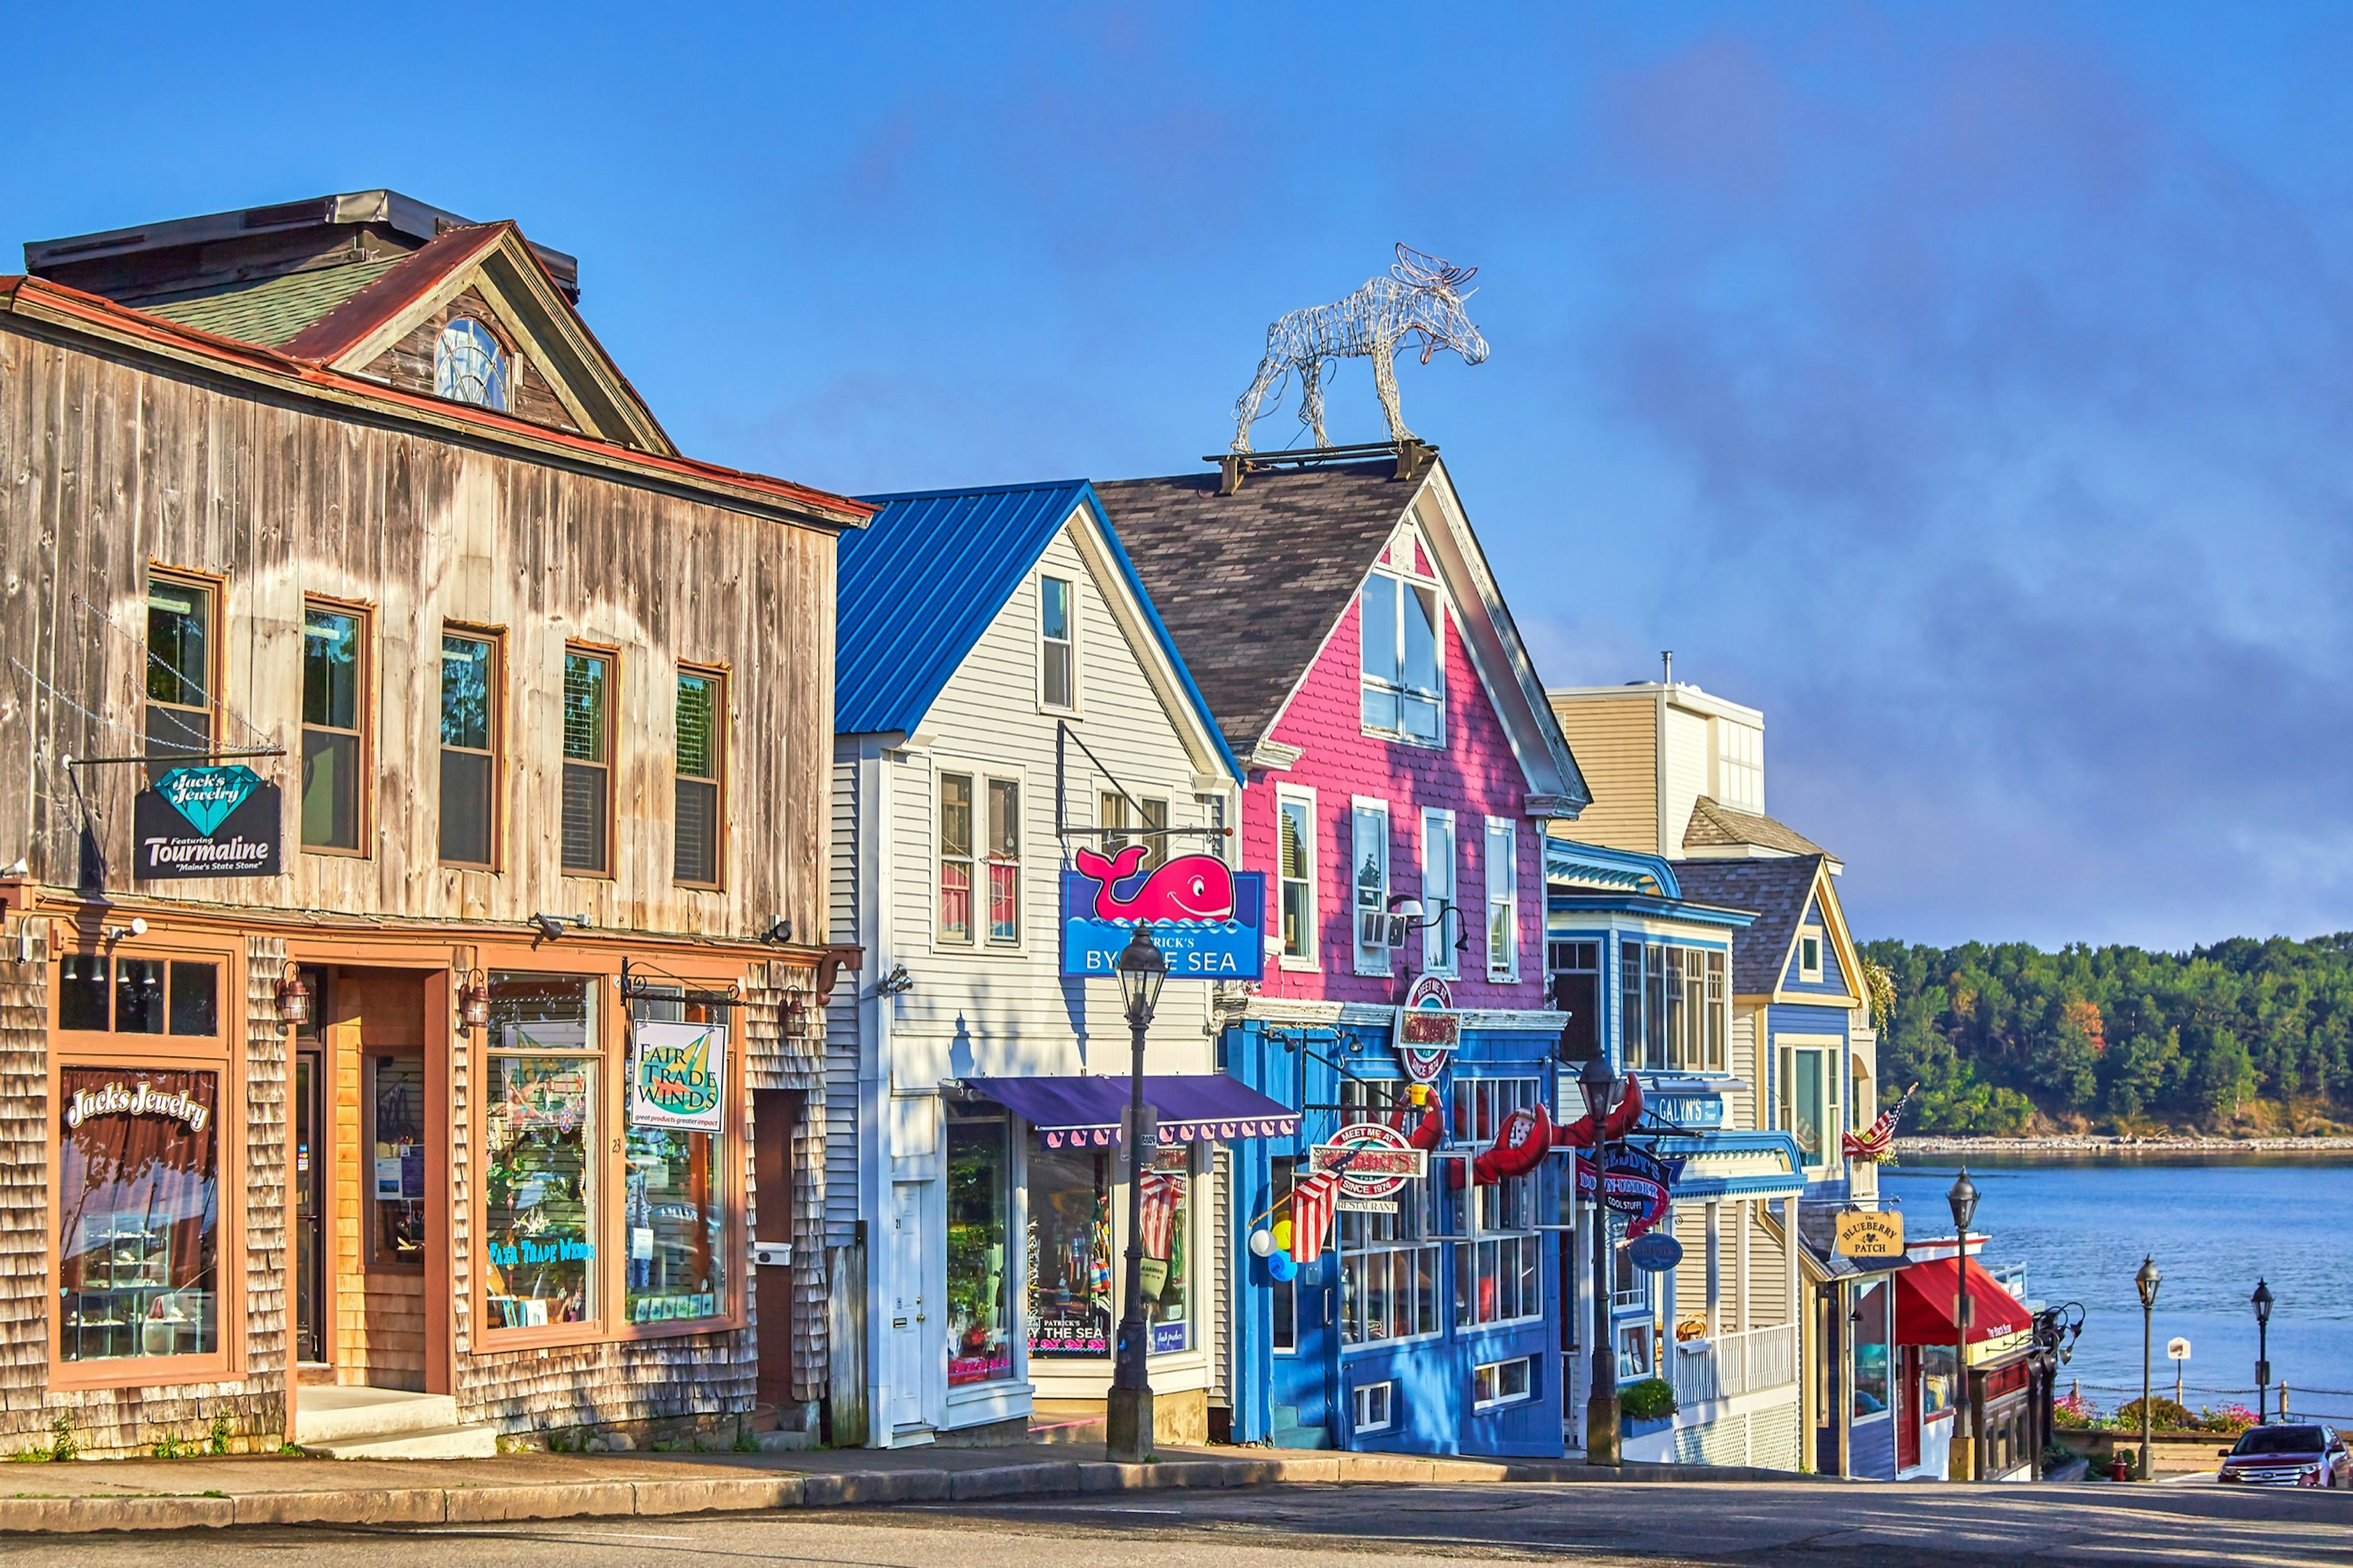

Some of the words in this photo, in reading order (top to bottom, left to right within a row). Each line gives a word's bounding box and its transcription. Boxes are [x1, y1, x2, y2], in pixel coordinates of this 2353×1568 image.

[173, 774, 225, 789] Jack's
[173, 788, 239, 804] Jewelry
[144, 835, 269, 866] Tourmaline
[175, 863, 210, 873] "Maine's
[211, 862, 234, 870] State
[1130, 937, 1194, 948] RICK'S
[1086, 951, 1118, 969] BY
[1188, 952, 1237, 972] SEA
[1417, 980, 1431, 999] MEET
[1432, 980, 1440, 994] ME
[1440, 987, 1447, 1000] AT
[640, 1043, 687, 1065] FAIR
[643, 1064, 716, 1088] TRADE
[1411, 1059, 1427, 1077] SINCE
[1428, 1060, 1439, 1075] 1974
[638, 1085, 716, 1109] WINDS
[68, 1081, 131, 1128] Jack's
[130, 1081, 208, 1132] Jewelry
[1659, 1097, 1702, 1122] GALYN'S
[697, 1118, 718, 1127] impact
[1341, 1128, 1366, 1142] MEET
[1366, 1128, 1381, 1137] ME
[1382, 1134, 1395, 1143] AT
[612, 1138, 621, 1154] 23
[1343, 1180, 1370, 1194] SINCE
[1373, 1181, 1392, 1193] 1974
[1580, 1171, 1659, 1199] DON-UNDER
[1337, 1200, 1396, 1212] RESTAURANT
[1607, 1196, 1624, 1209] COOL
[1623, 1200, 1642, 1210] STUFF!
[1842, 1222, 1897, 1241] BLUEBERRY
[489, 1242, 519, 1265] FAIR
[521, 1240, 558, 1263] TRADE
[559, 1238, 596, 1261] WINDS
[1854, 1244, 1886, 1252] PATCH
[1044, 1327, 1072, 1338] THE
[1076, 1327, 1104, 1338] SEA
